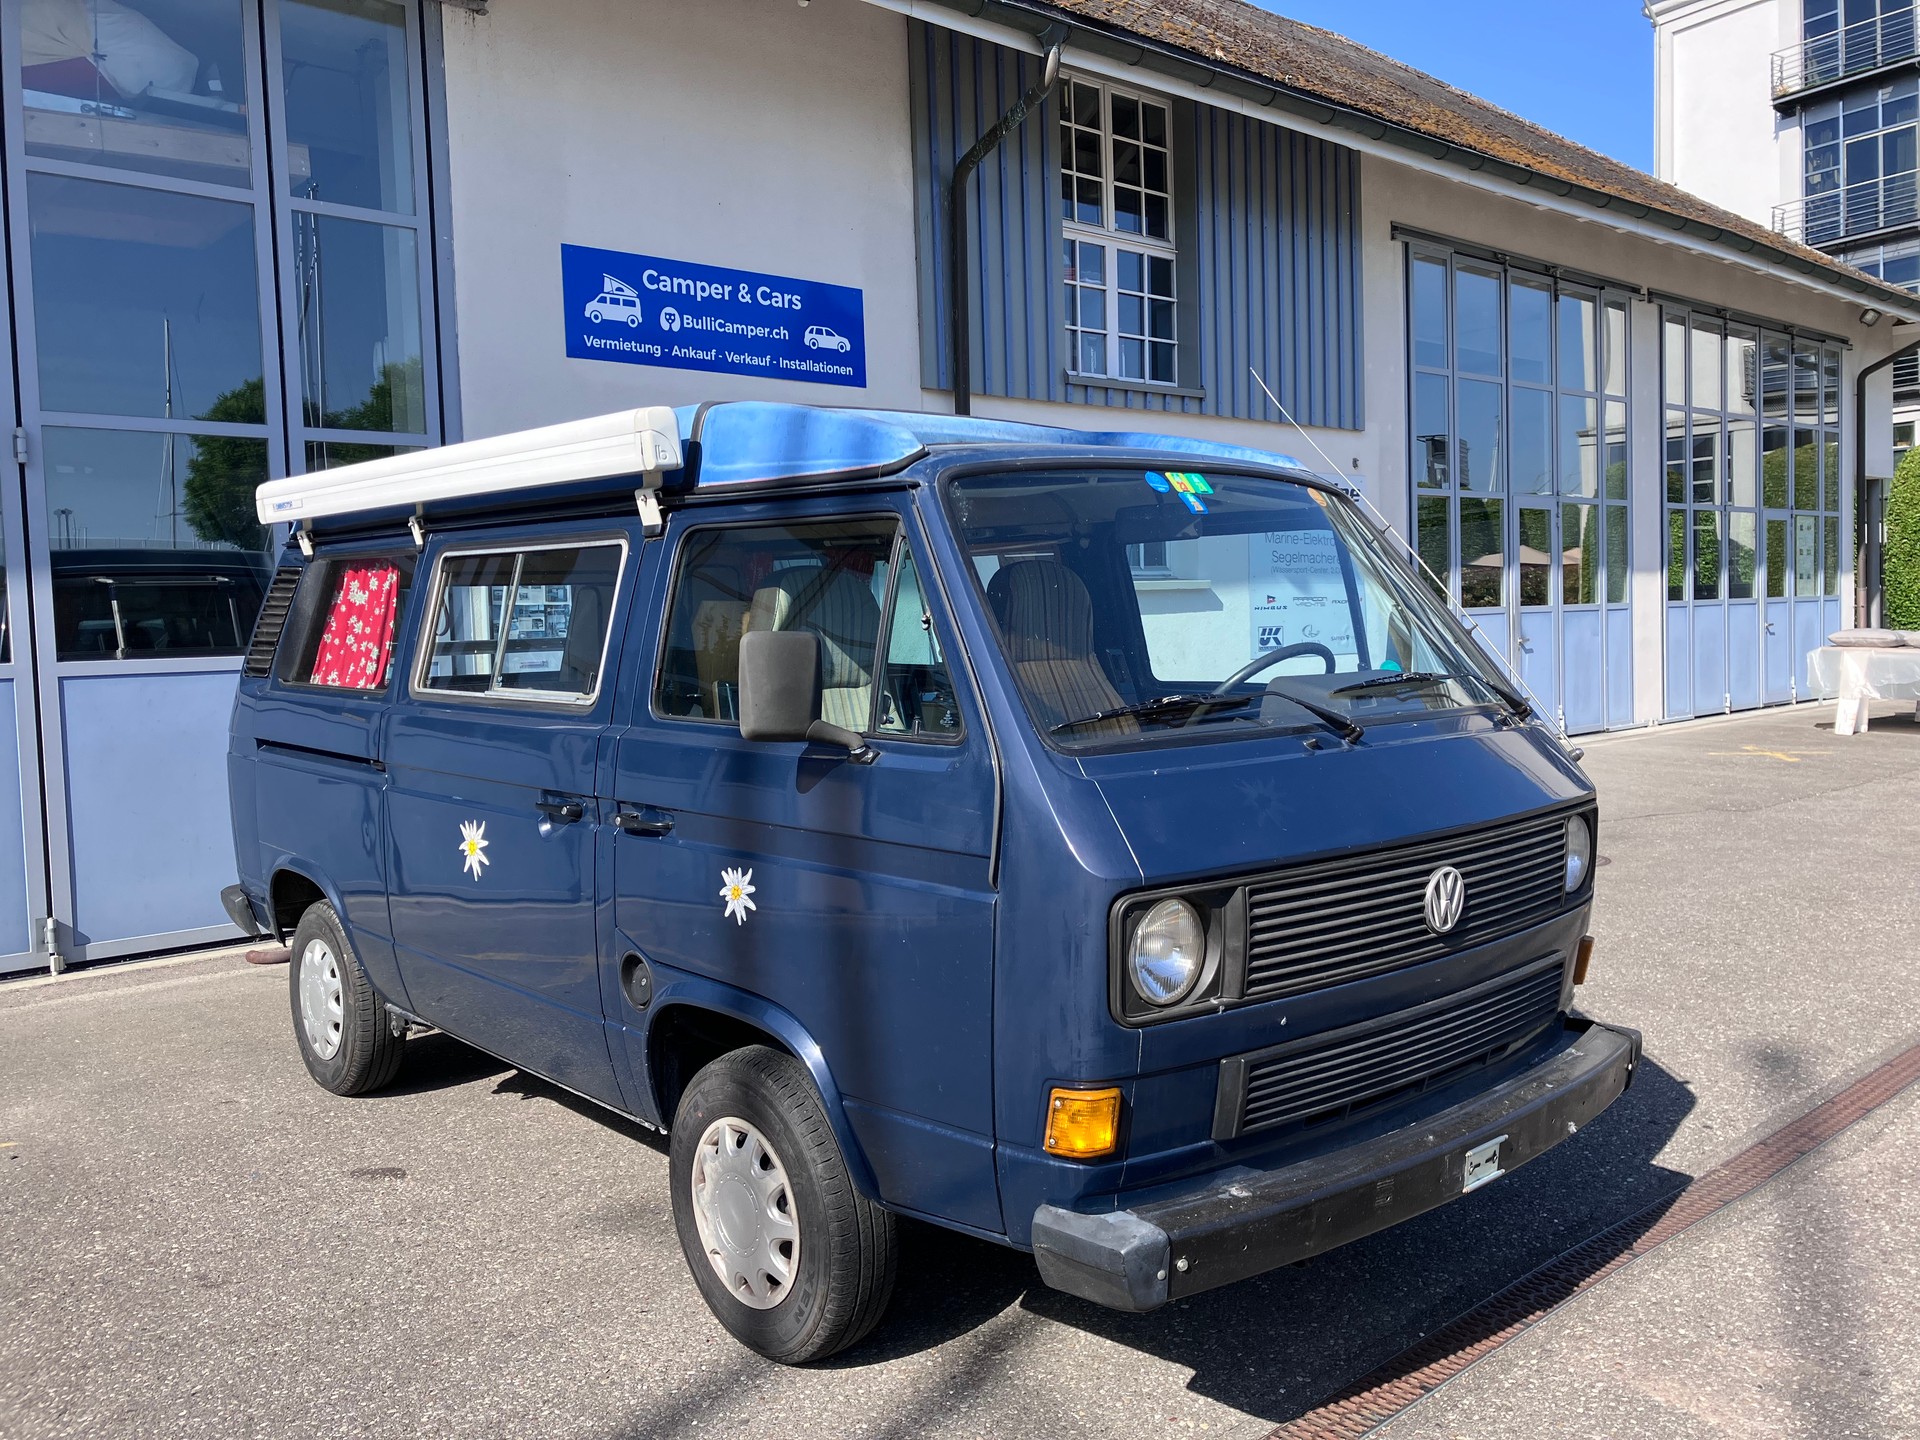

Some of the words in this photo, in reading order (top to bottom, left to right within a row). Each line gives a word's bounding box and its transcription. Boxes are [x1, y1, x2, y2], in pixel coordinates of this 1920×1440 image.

[642, 269, 732, 302] Camper
[737, 283, 752, 304] &
[756, 286, 802, 310] Cars
[683, 314, 789, 340] BulliCamper.ch
[583, 334, 662, 357] Vermietung
[672, 345, 716, 361] Ankauf
[725, 352, 770, 367] Verkauf
[779, 357, 853, 376] Installationen
